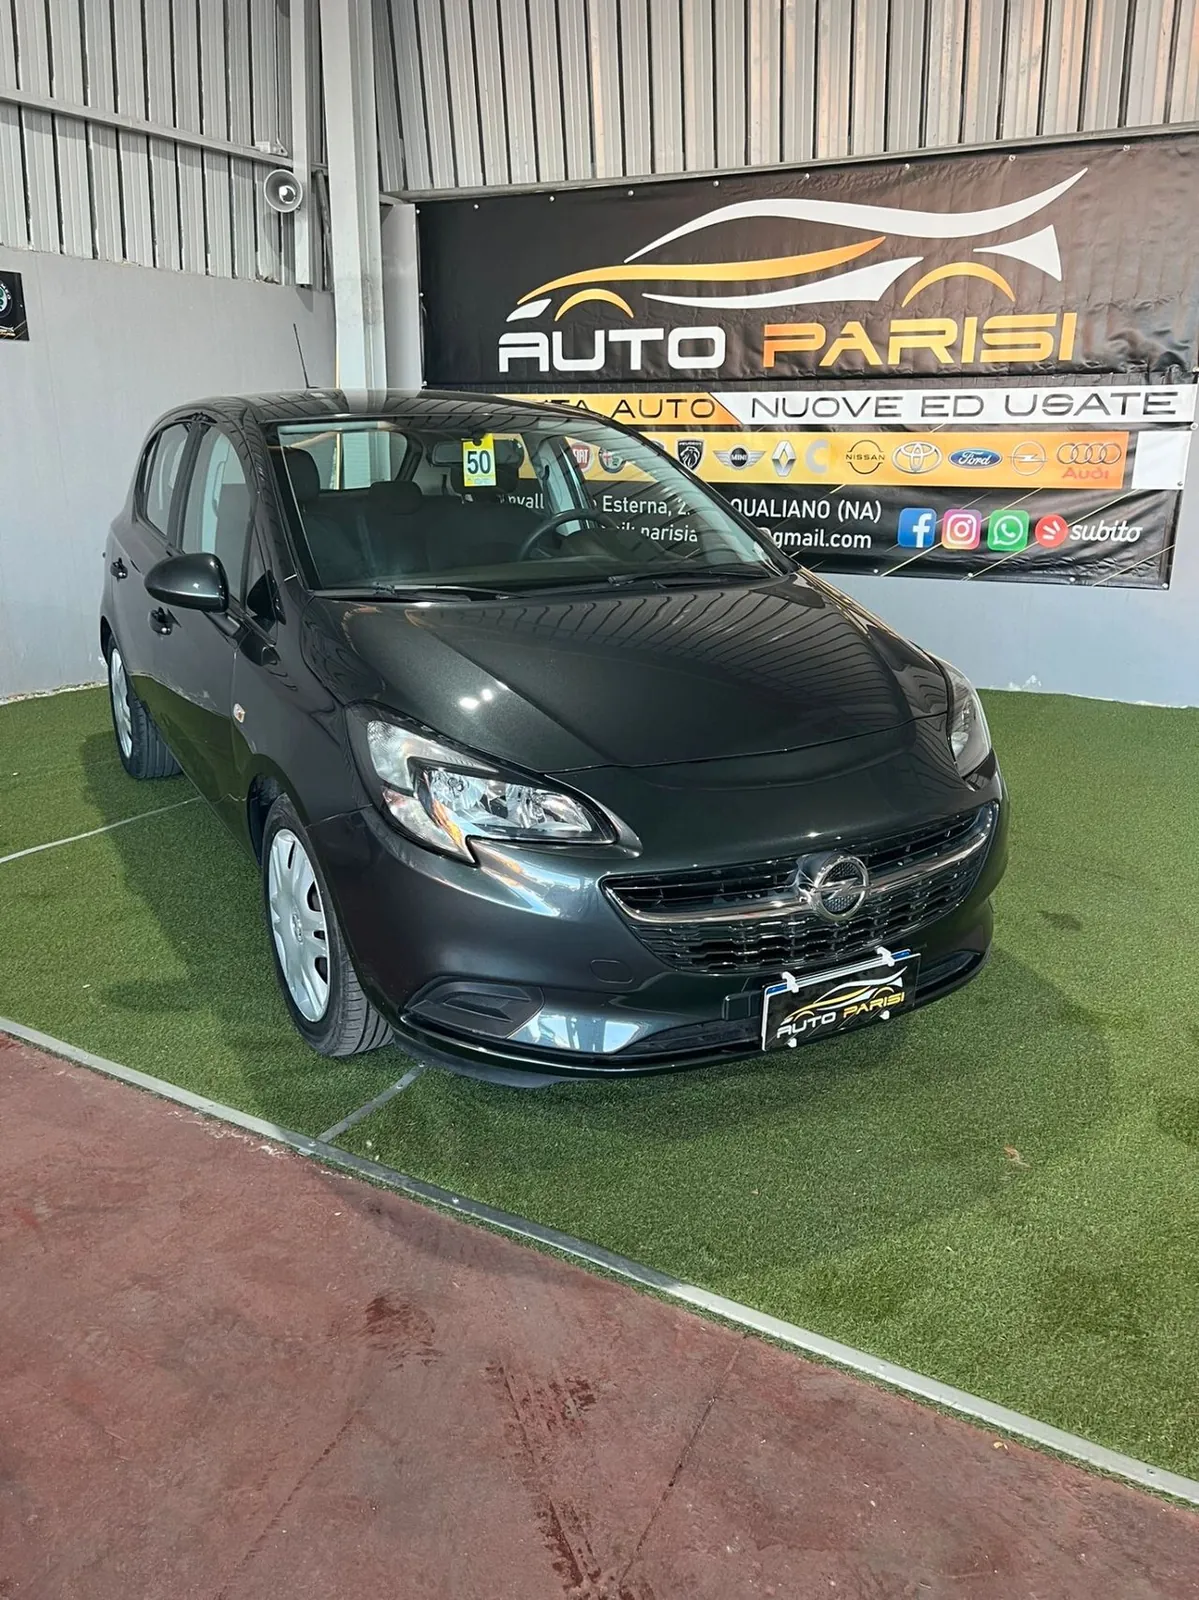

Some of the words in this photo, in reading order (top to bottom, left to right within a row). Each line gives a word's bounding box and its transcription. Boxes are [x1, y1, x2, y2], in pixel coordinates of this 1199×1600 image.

[498, 326, 726, 373] AUTO
[762, 312, 1078, 369] PARISI
[610, 398, 716, 419] AUTO
[751, 395, 903, 418] NUOVE
[920, 395, 984, 418] ED
[1004, 391, 1179, 416] USATE
[467, 450, 492, 475] 50
[958, 450, 991, 465] Ford
[1061, 467, 1110, 480] Audi
[602, 495, 673, 517] Esterna,
[837, 499, 882, 524] (NA)
[1069, 519, 1143, 542] subito
[776, 1011, 836, 1039] AUTO
[843, 991, 905, 1018] PARISI
